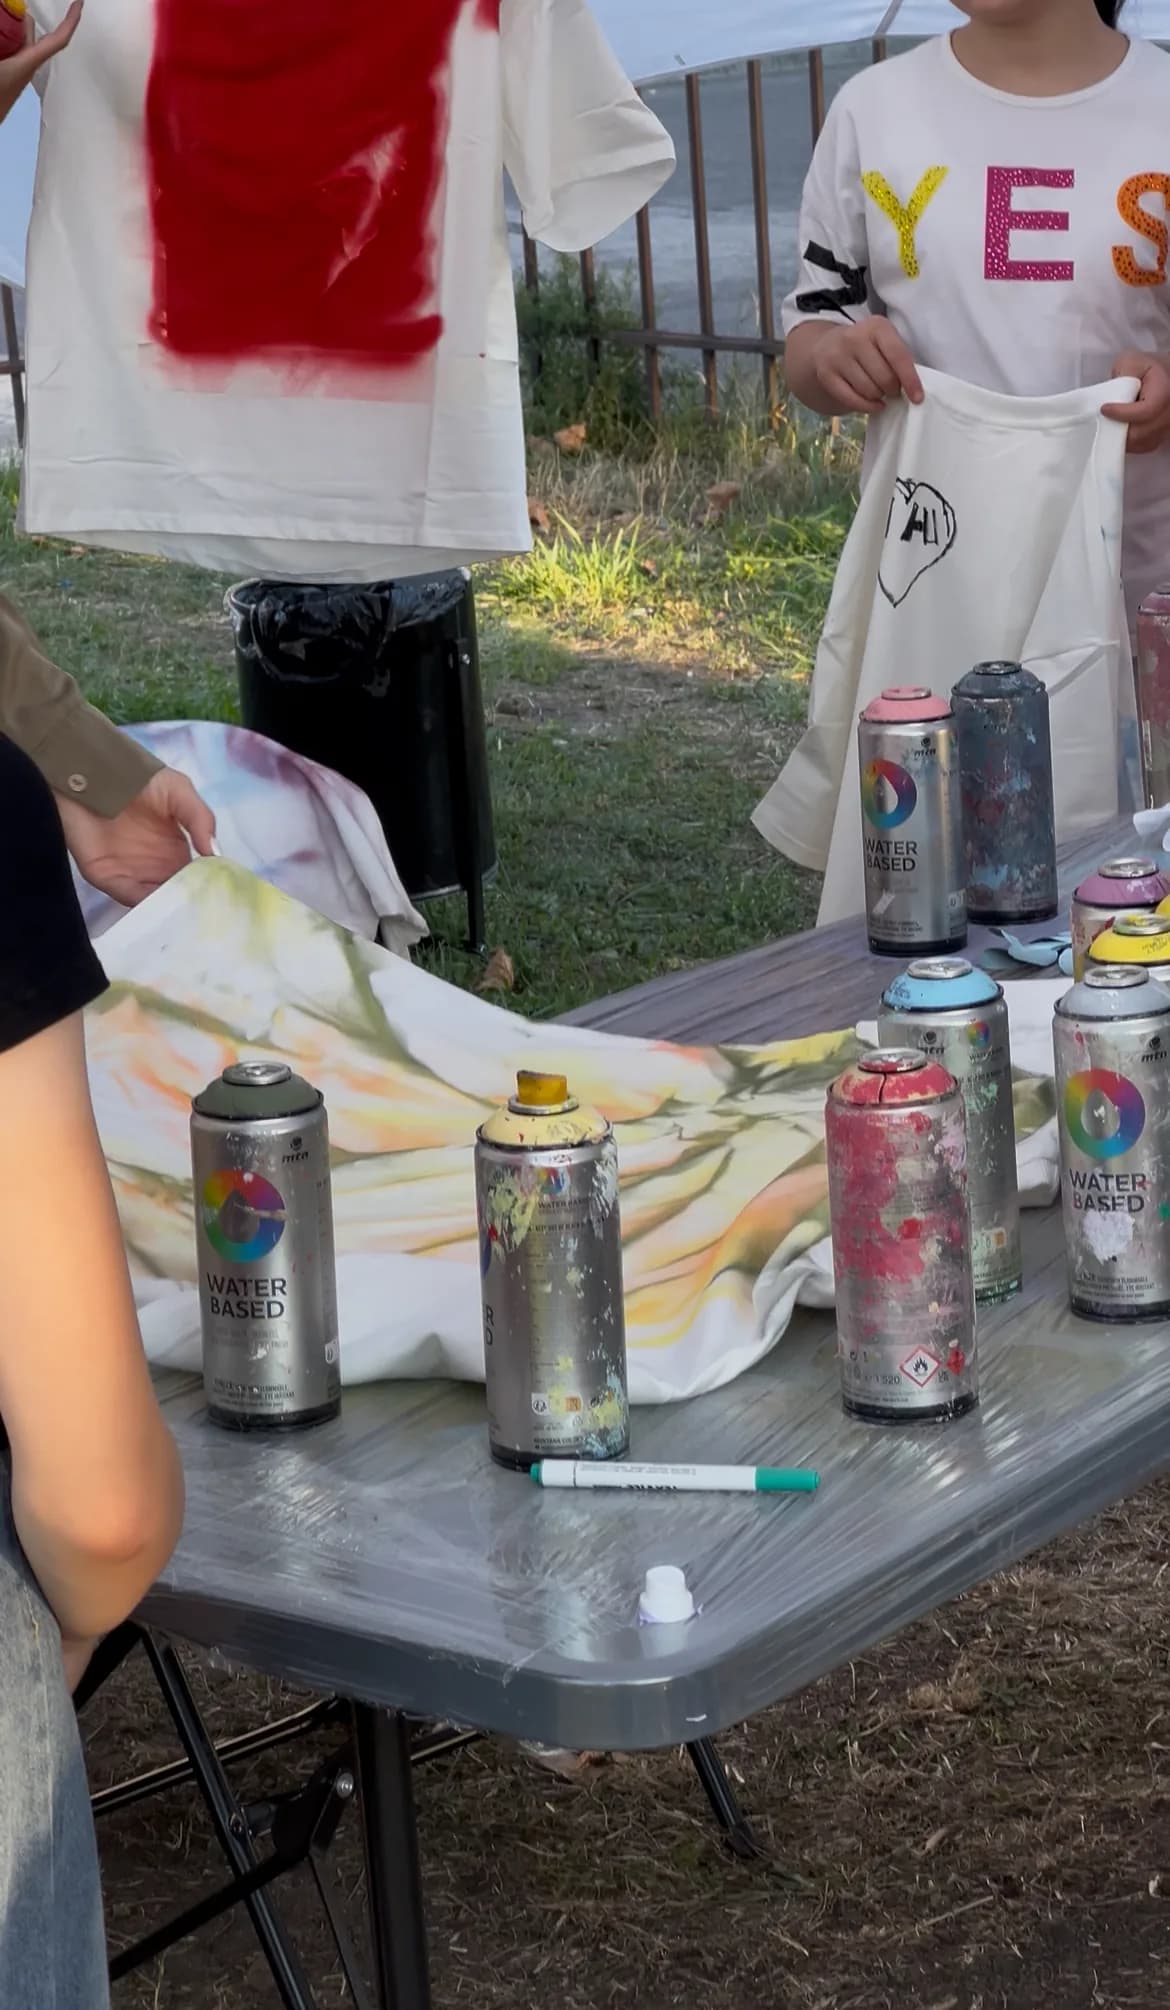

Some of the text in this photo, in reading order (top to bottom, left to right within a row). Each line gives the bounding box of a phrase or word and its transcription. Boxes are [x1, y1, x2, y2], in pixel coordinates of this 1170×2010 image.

[862, 165, 1170, 288] YES
[864, 838, 917, 856] WATER
[866, 854, 916, 872] BASED
[1069, 1168, 1147, 1192] WATER
[1074, 1191, 1145, 1214] BASED
[206, 1271, 287, 1297] WATER
[211, 1296, 284, 1319] BASED
